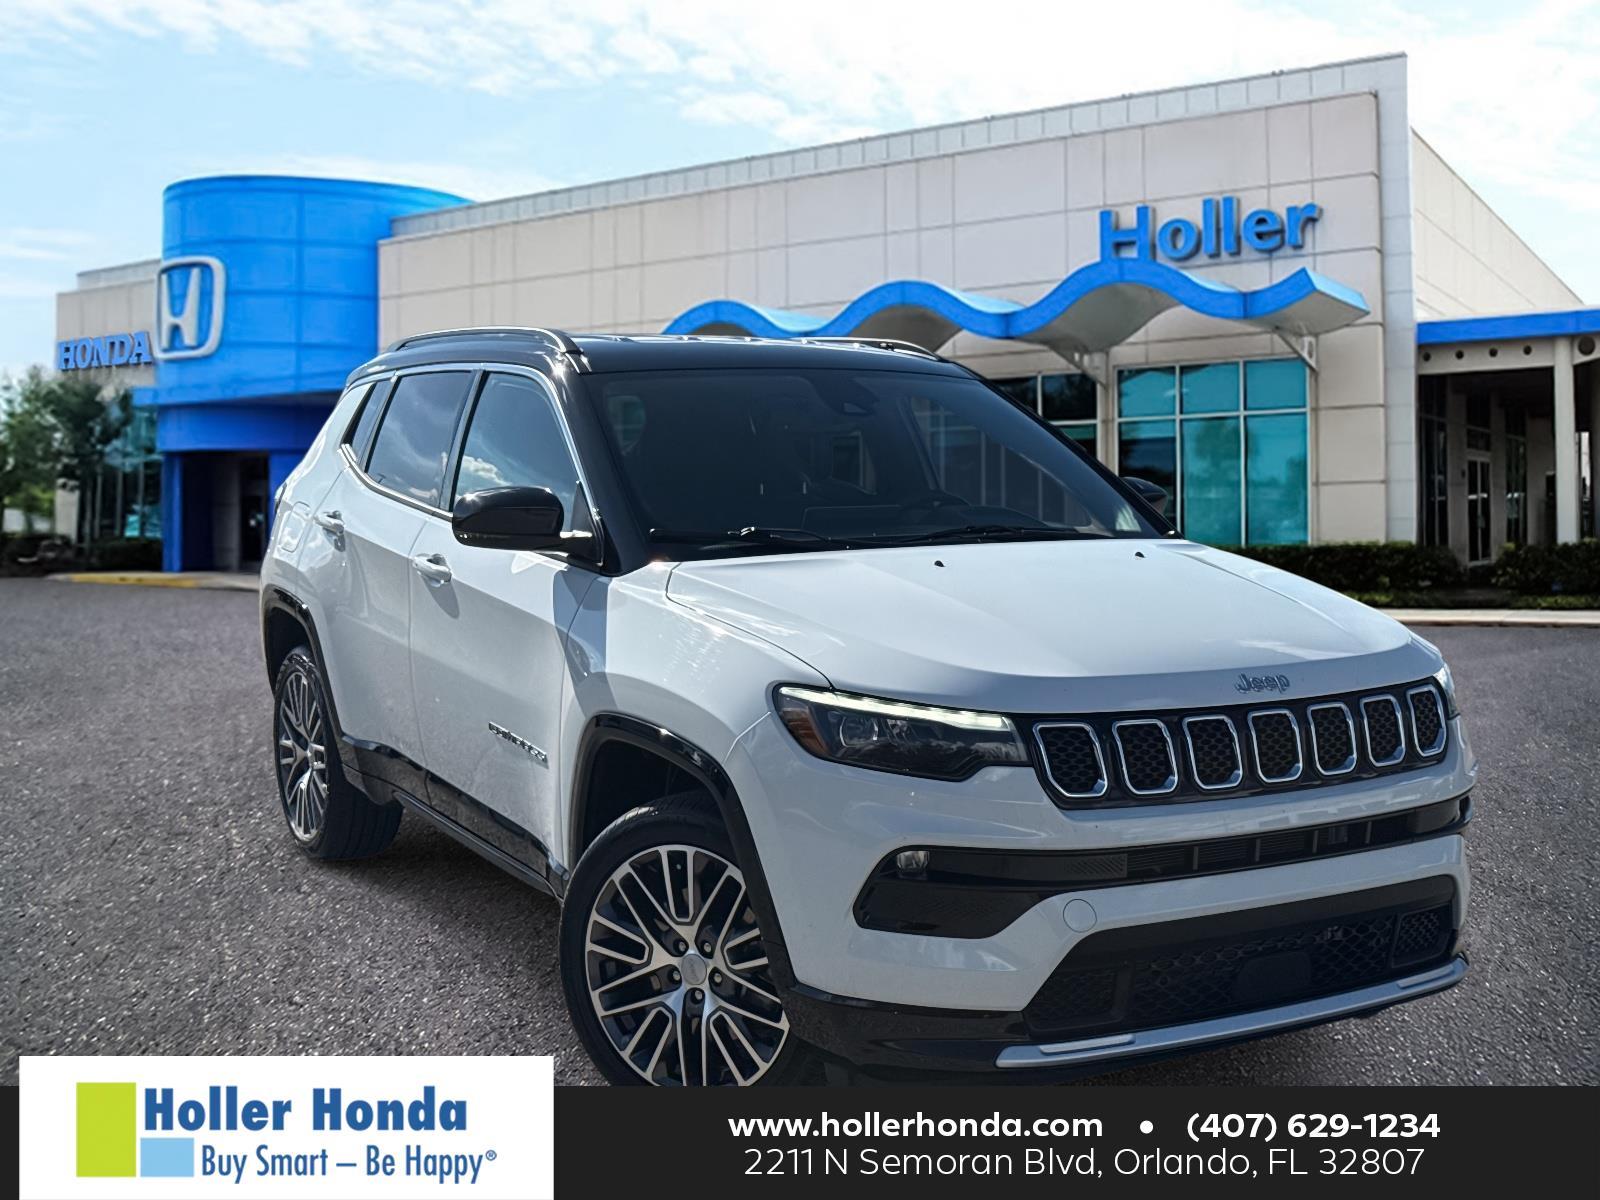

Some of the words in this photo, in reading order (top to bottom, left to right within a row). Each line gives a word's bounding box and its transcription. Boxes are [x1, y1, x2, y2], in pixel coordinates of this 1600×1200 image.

[1099, 195, 1321, 260] Holler
[58, 331, 152, 371] HONDA
[1235, 673, 1290, 695] Jeep
